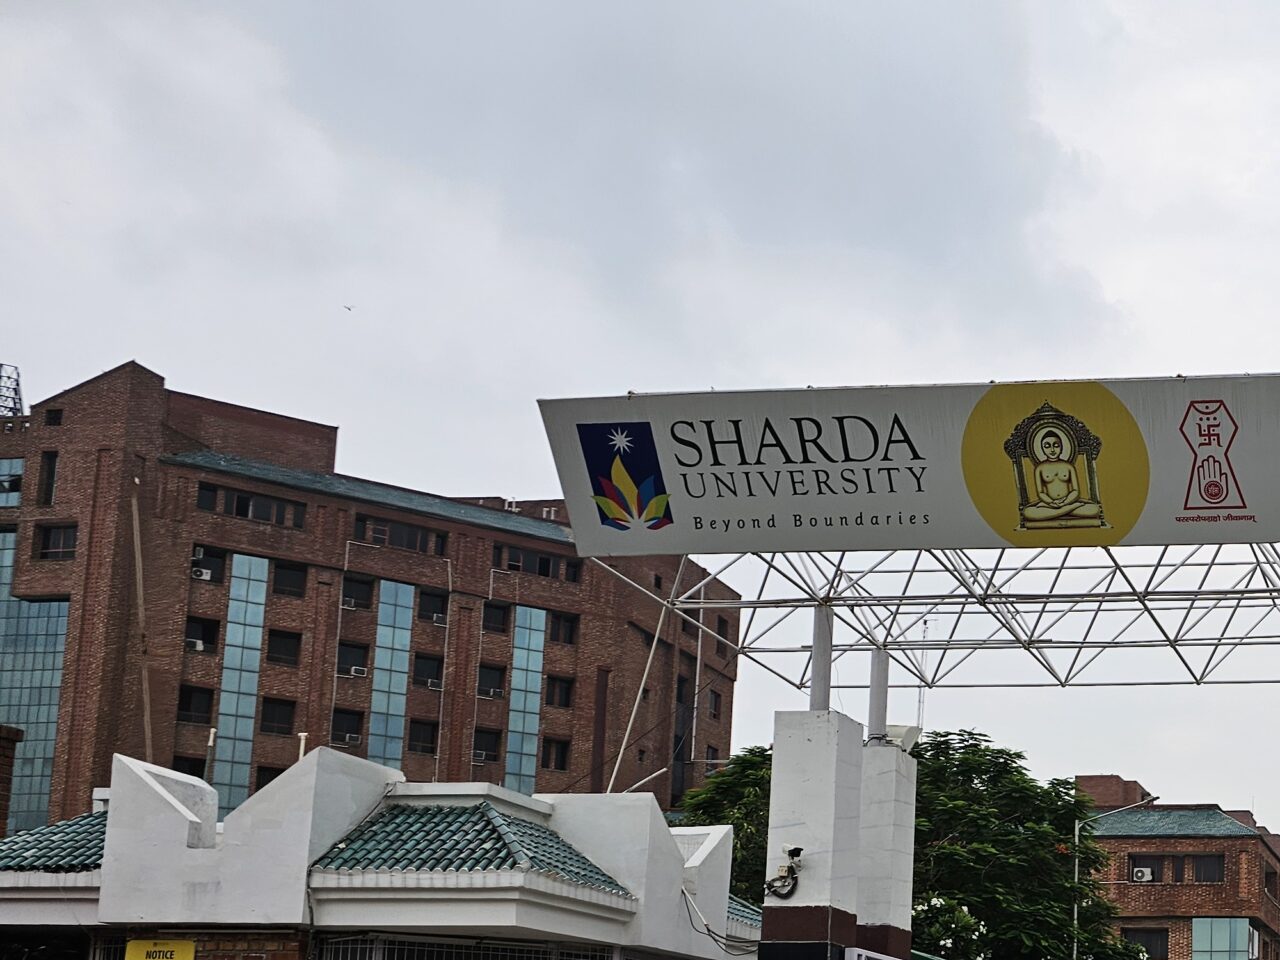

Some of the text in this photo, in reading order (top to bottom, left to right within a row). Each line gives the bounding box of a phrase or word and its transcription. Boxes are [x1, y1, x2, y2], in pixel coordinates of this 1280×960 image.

[670, 413, 927, 468] SHARDA
[679, 466, 928, 499] UNIVERSITY
[693, 512, 930, 532] Beyond Boundaries
[145, 950, 175, 960] NOTICE
